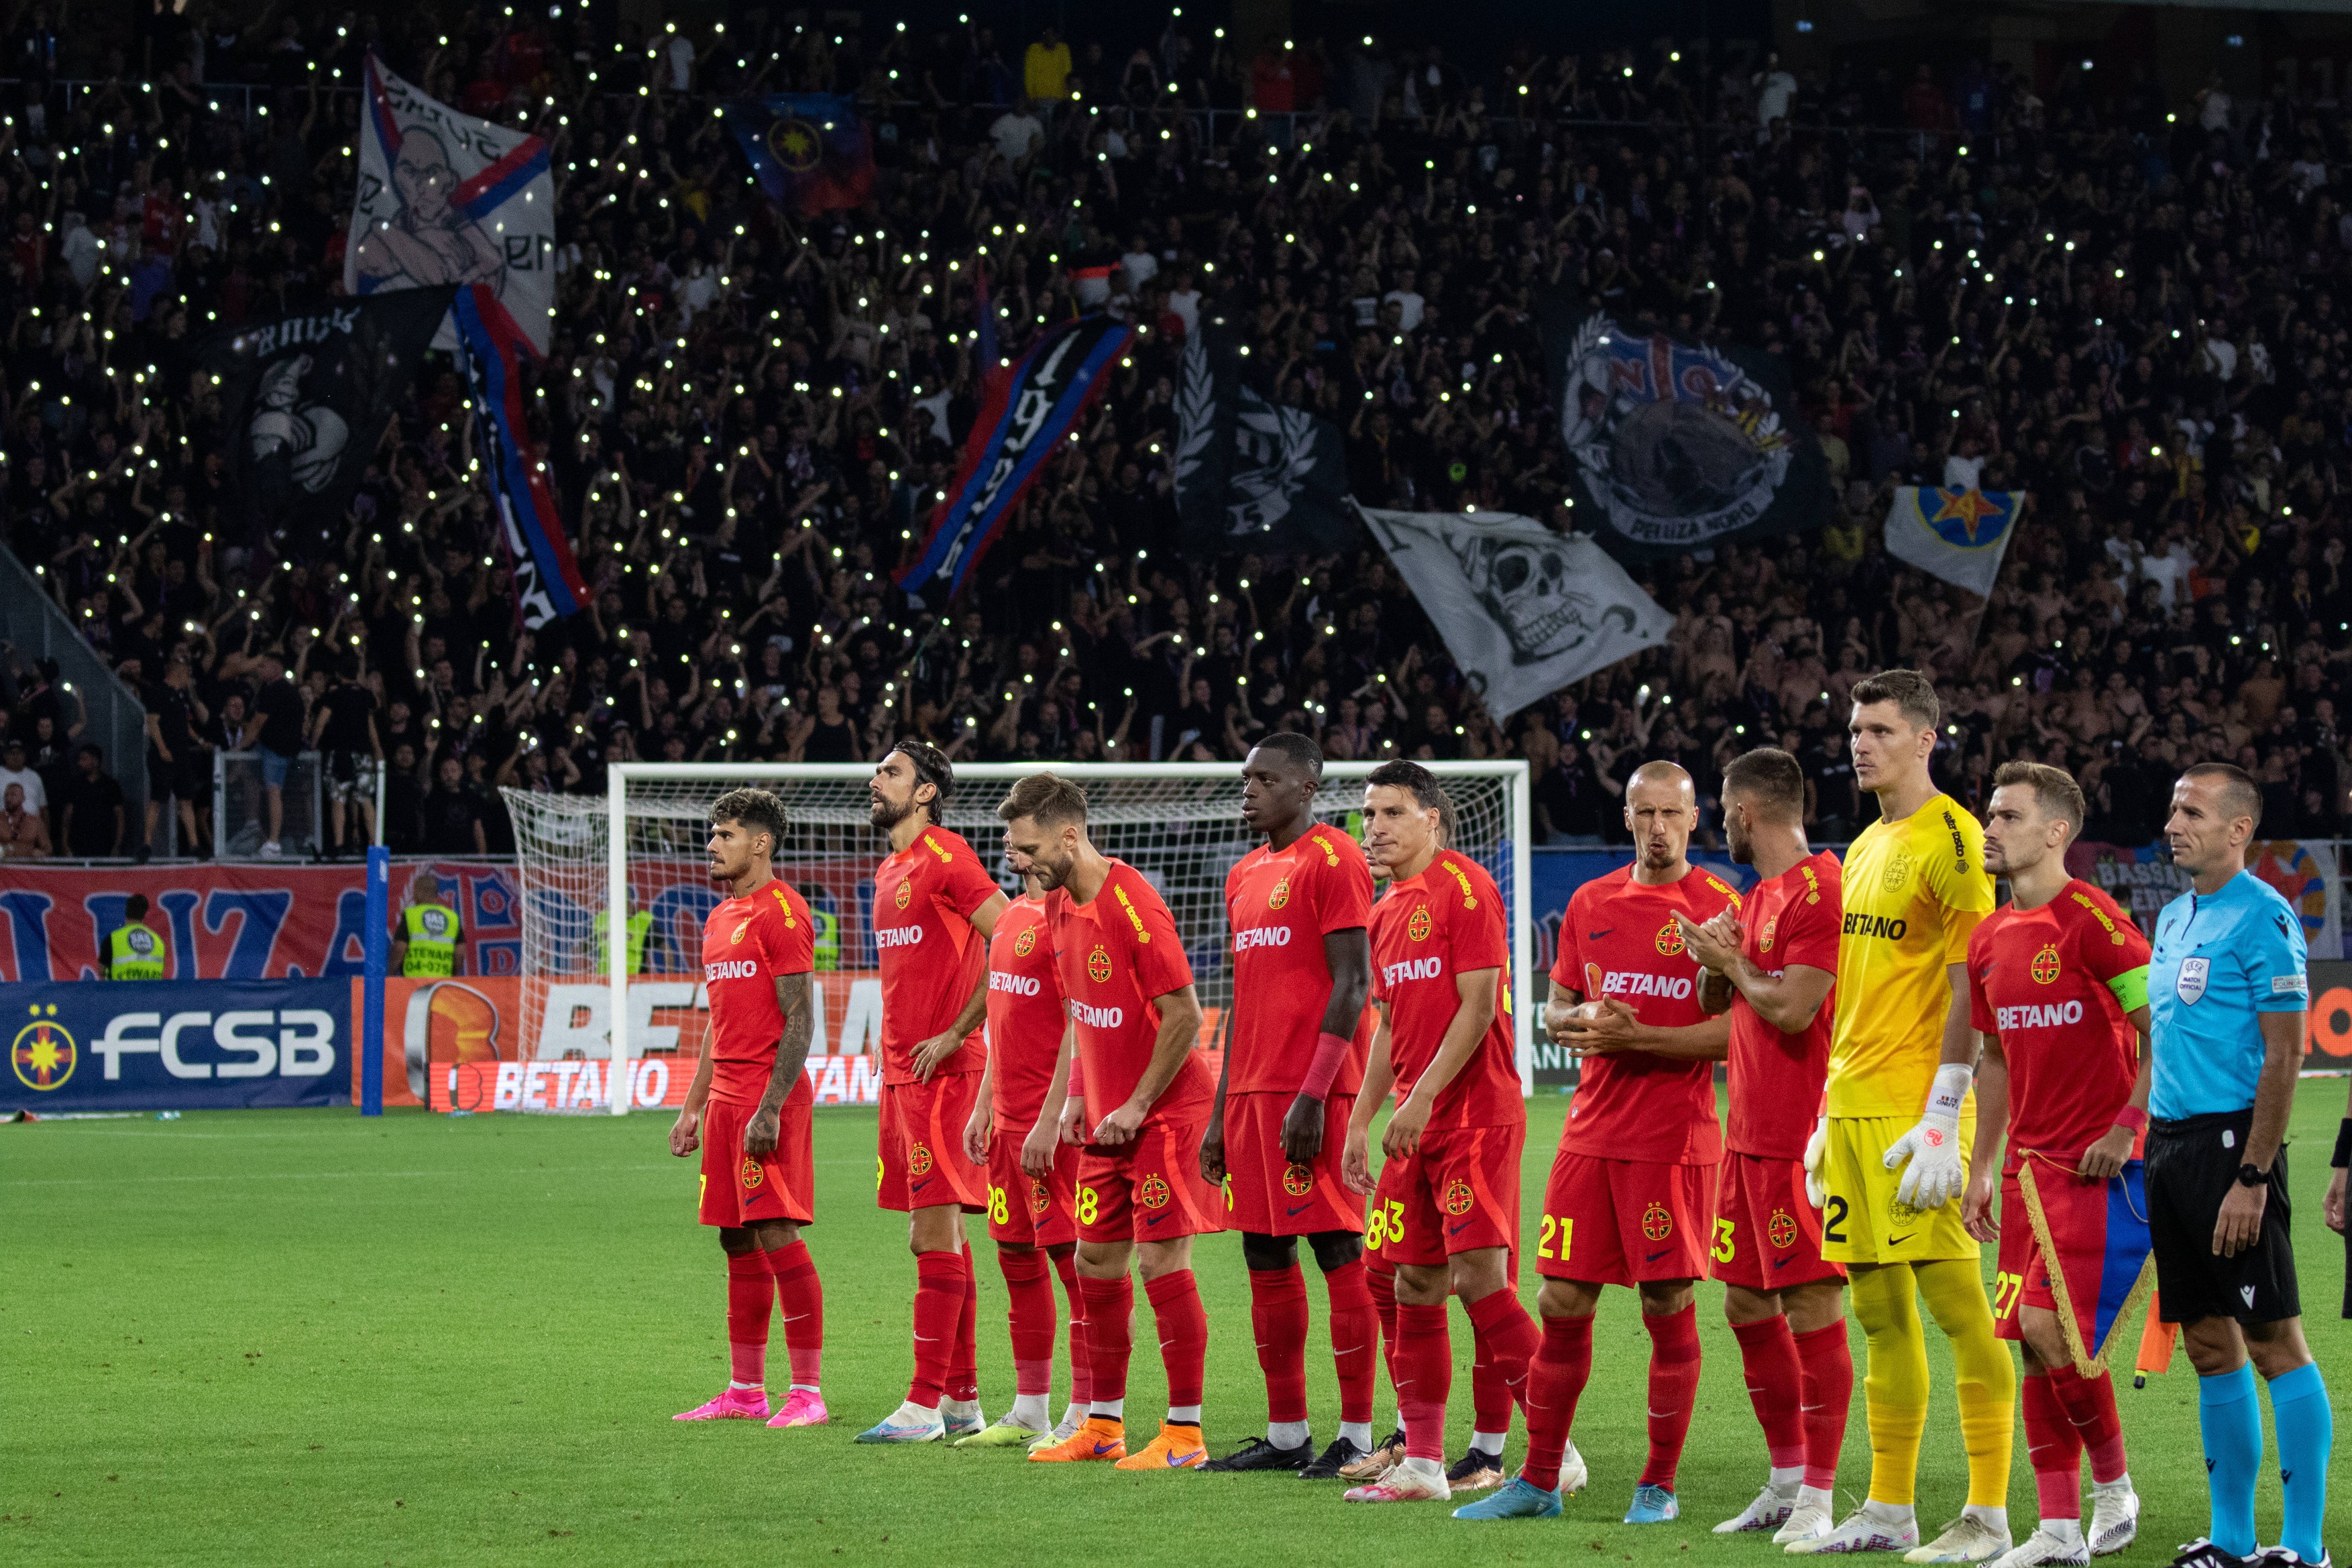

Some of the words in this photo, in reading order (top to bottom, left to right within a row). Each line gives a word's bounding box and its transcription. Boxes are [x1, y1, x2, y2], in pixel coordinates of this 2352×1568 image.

[1951, 831, 1965, 858] tosto
[1113, 883, 1131, 907] walter
[1126, 905, 1144, 932] tosto
[875, 924, 923, 949] BETANO
[1235, 926, 1292, 952] BETANO
[1842, 912, 1907, 941] BETANO
[704, 960, 757, 982] BETANO
[1382, 956, 1442, 988] BETANO
[2185, 960, 2204, 973] UEFA
[989, 970, 1040, 997] BETANO
[1601, 970, 1691, 1000] BETANO
[2179, 983, 2202, 991] OFFICIAL
[1070, 998, 1123, 1029] BETANO
[1997, 999, 2083, 1031] BETANO
[91, 1009, 335, 1080] FCSB
[1537, 1213, 1574, 1262] 21
[1995, 1270, 2023, 1321] 27
